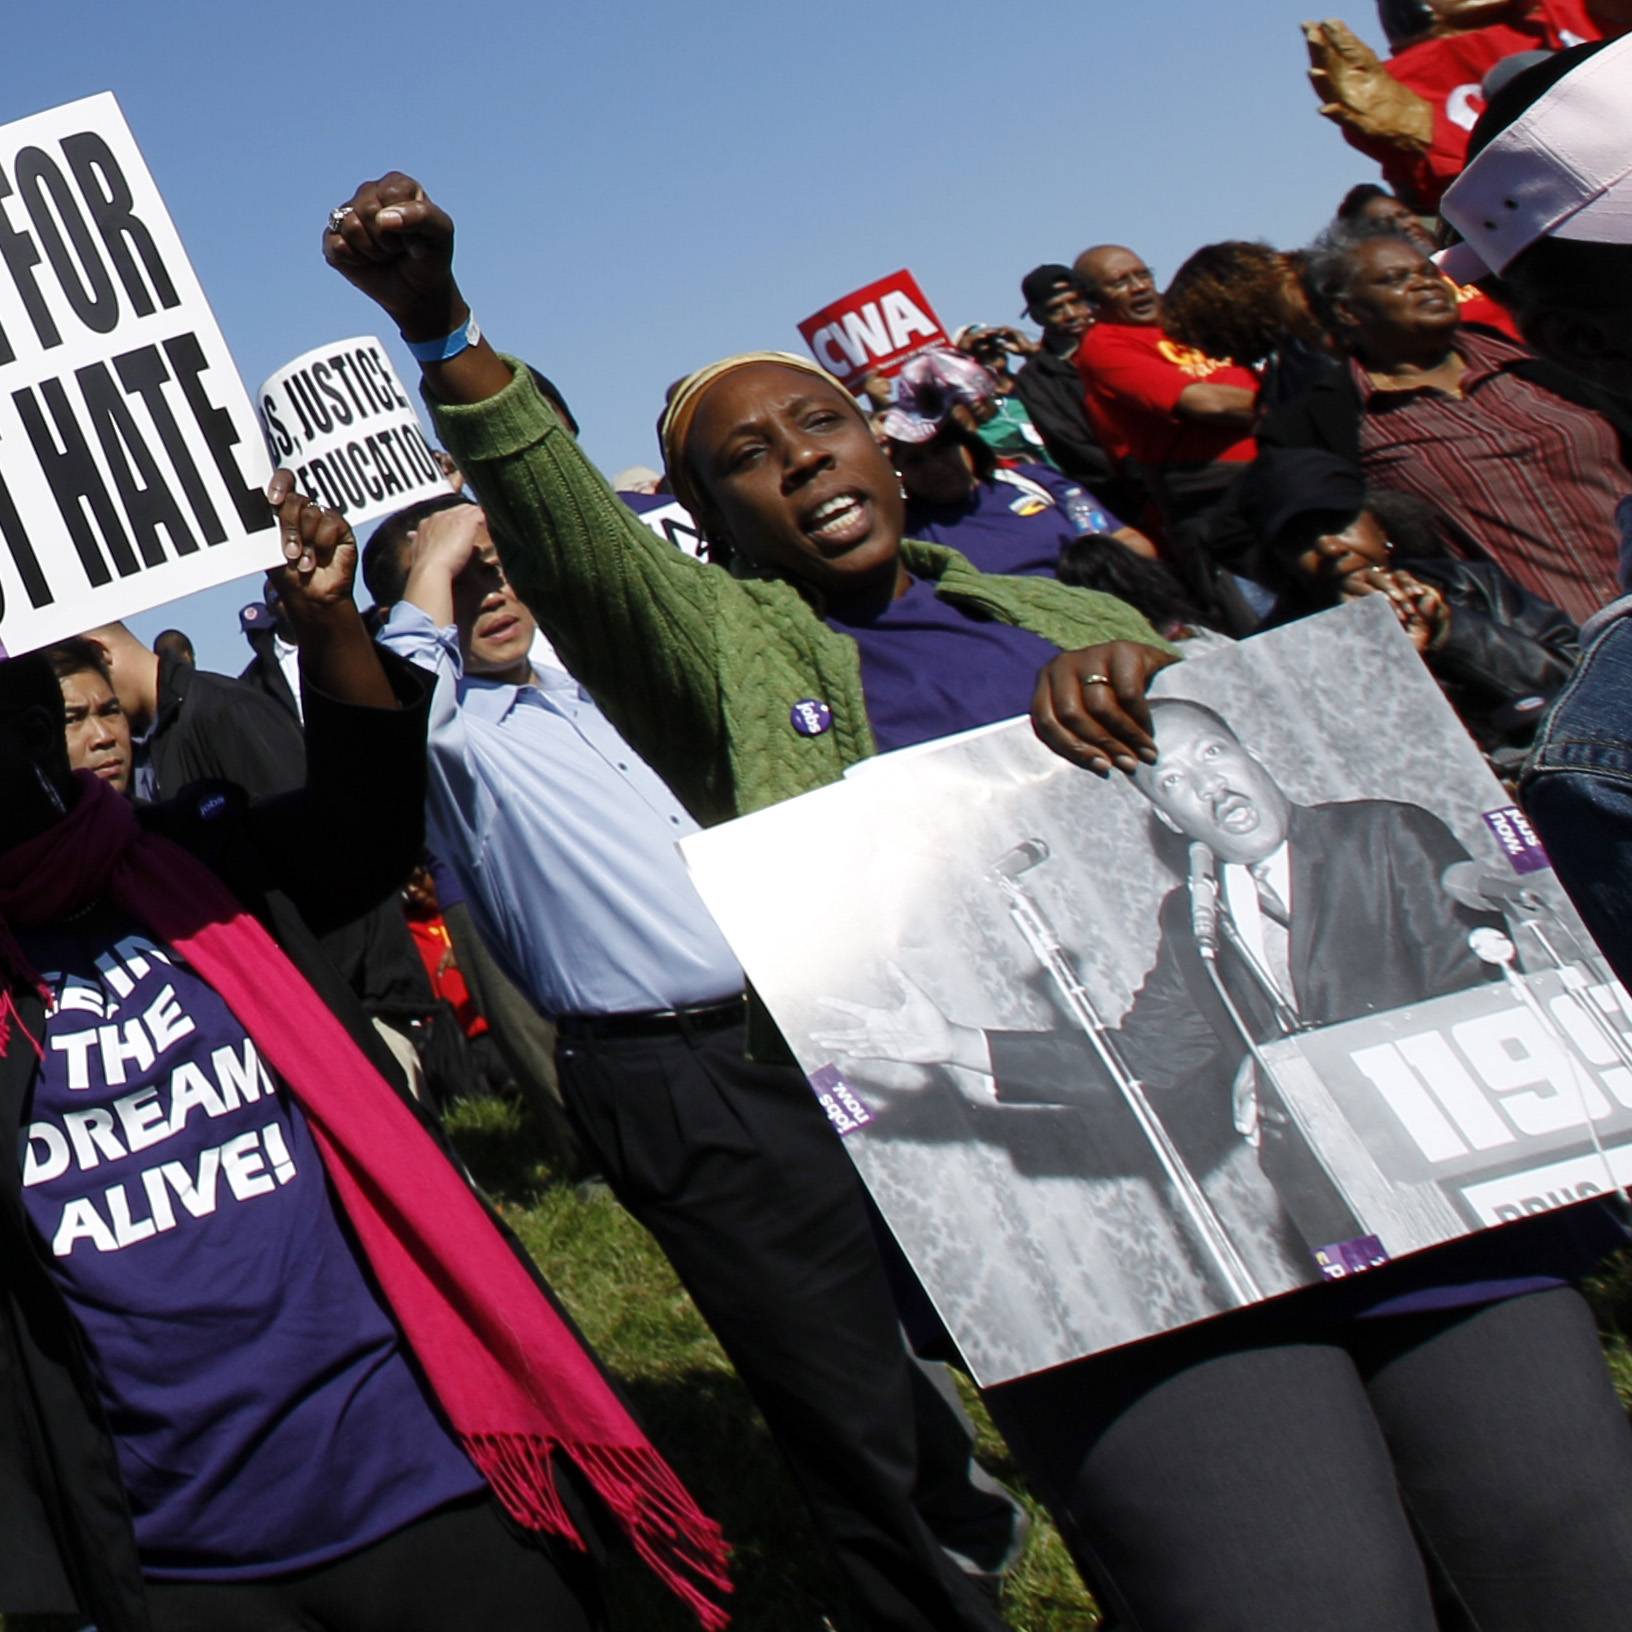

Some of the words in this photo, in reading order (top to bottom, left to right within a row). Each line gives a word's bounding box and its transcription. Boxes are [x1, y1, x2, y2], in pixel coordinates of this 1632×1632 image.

[812, 289, 939, 377] CWA
[15, 331, 275, 588] HATE
[795, 701, 822, 733] jobs
[1488, 812, 1526, 855] now.
[51, 984, 196, 1090] THE
[21, 1037, 276, 1188] DREAM
[819, 1093, 858, 1134] jobs
[832, 1081, 870, 1124] now.
[52, 1122, 297, 1256] ALIVE!
